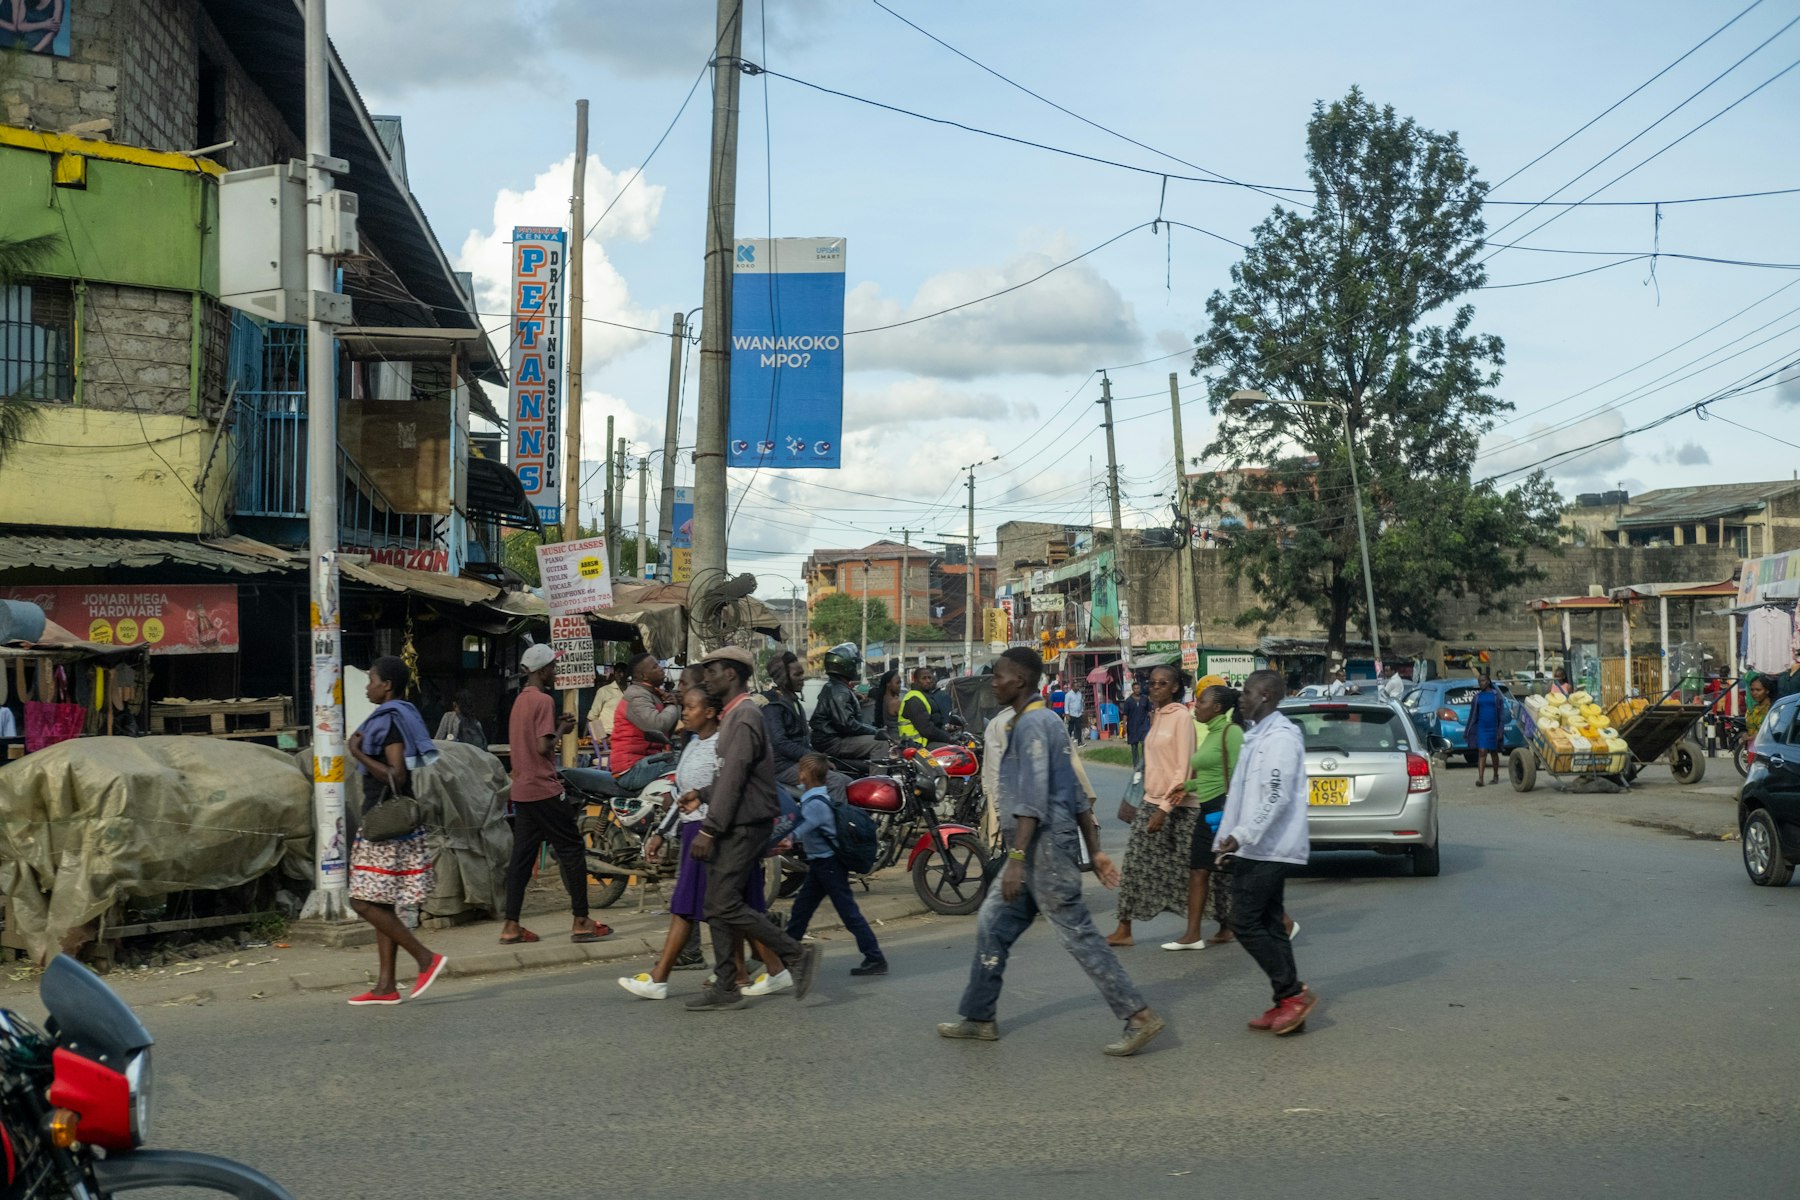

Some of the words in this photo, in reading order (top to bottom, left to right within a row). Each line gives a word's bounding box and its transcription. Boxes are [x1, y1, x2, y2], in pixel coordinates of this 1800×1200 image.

[547, 250, 559, 370] DRIVING
[732, 335, 840, 351] WANAKOKO
[760, 353, 811, 368] MPO?
[515, 245, 547, 495] PETANNS
[546, 379, 556, 488] SCHOOL
[541, 545, 567, 556] MUSIC
[568, 540, 604, 552] CLASSES
[545, 556, 564, 564] PIANO
[546, 565, 568, 573] GUITAR
[547, 573, 568, 582] VIOLIN
[549, 582, 572, 591] VOCALS
[82, 593, 130, 606] JOMARI
[132, 593, 169, 605] MEGA
[551, 589, 586, 600] SAXOPHONE
[89, 605, 163, 617] HARDWARE
[553, 627, 591, 639] SCHOOL
[553, 640, 593, 651] KCPE/KCSE
[555, 663, 593, 674] BEGINNERS
[1314, 792, 1346, 803] 195Y
